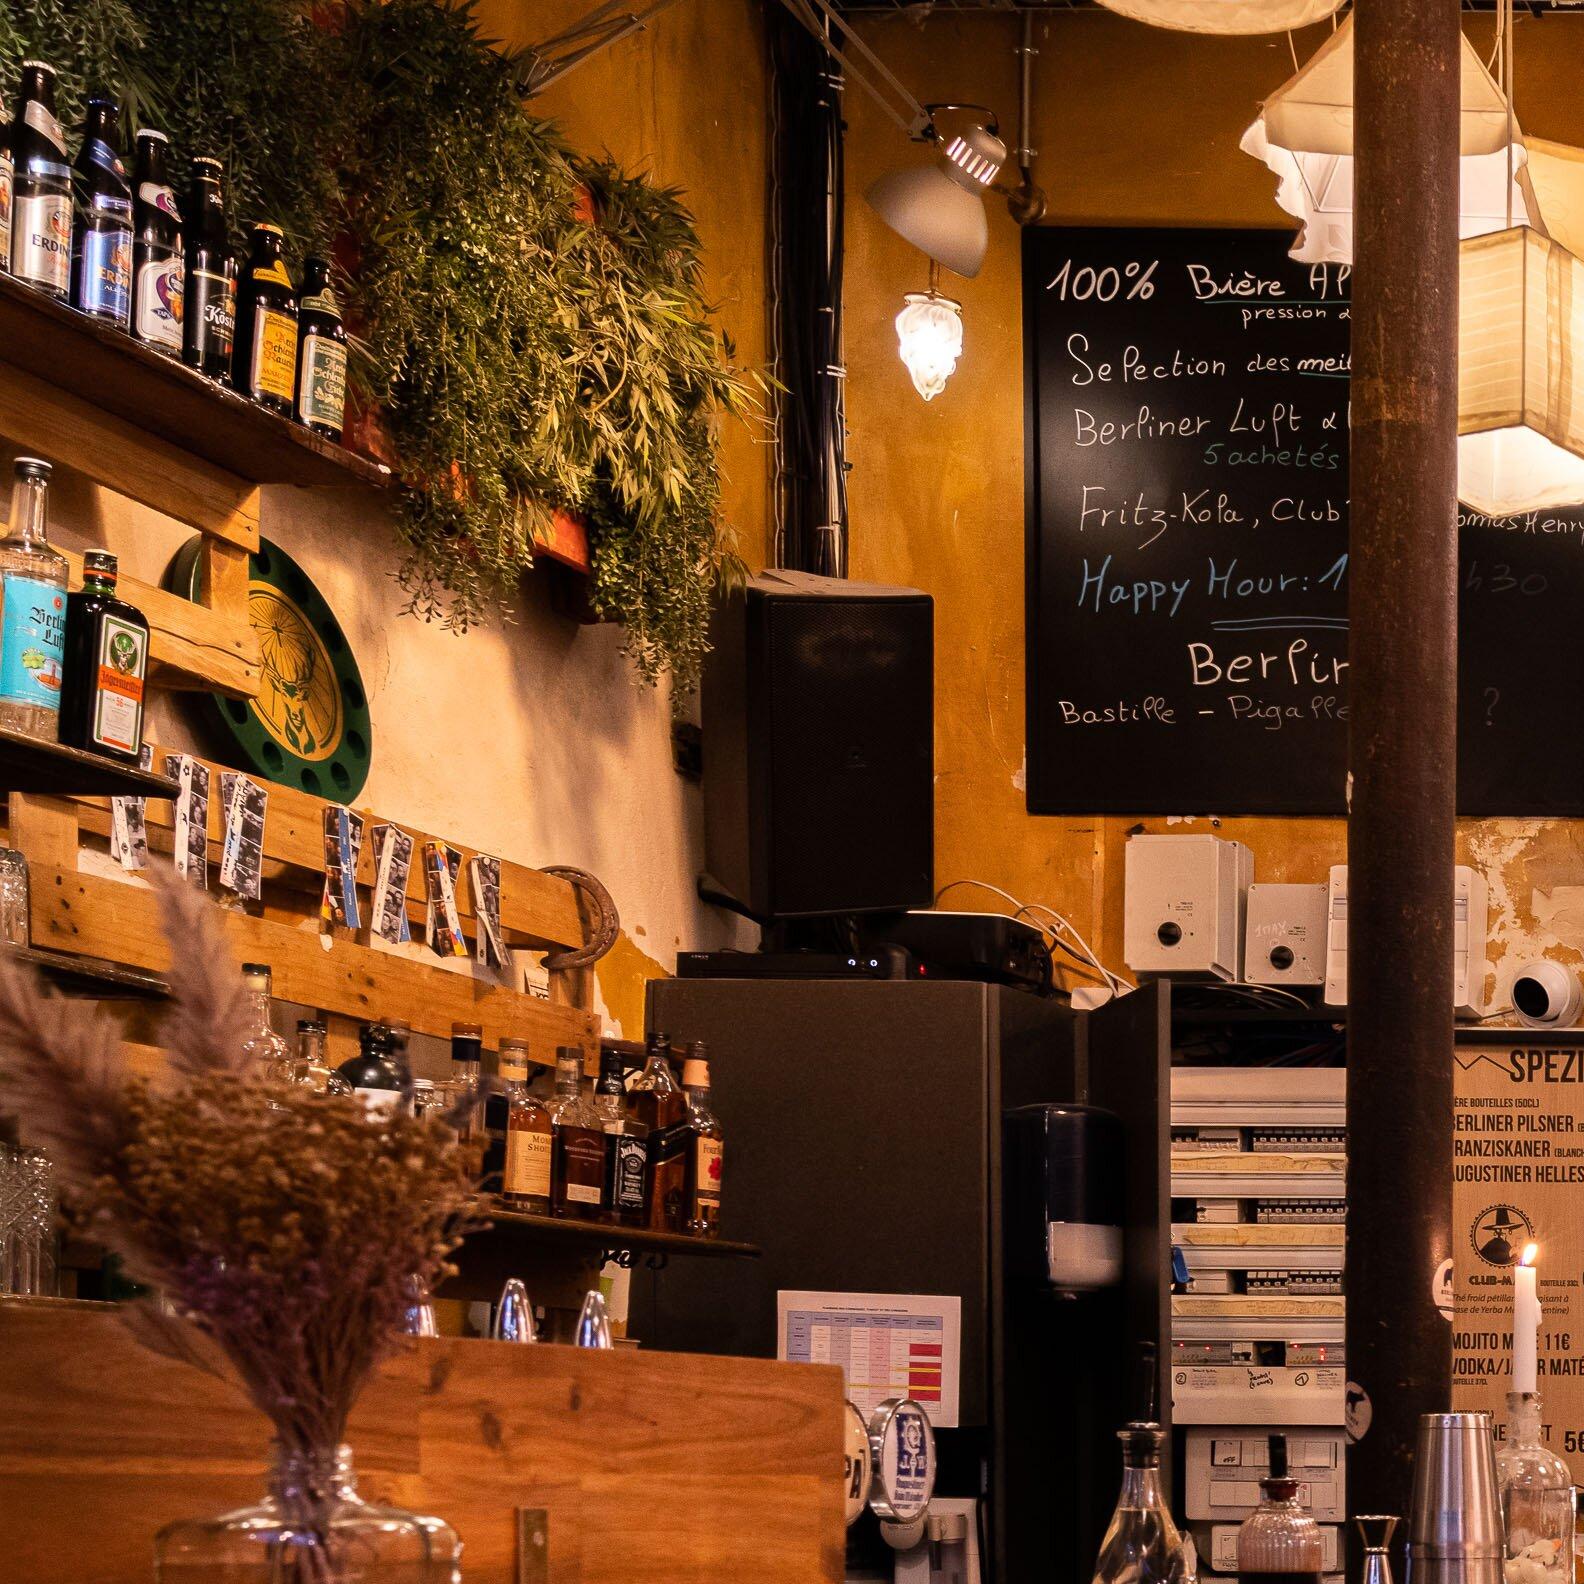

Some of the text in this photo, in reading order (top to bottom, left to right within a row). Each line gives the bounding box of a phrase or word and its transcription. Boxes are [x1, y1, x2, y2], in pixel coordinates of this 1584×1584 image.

[1046, 259, 1161, 302] 100%
[1187, 263, 1286, 300] Bière
[1241, 304, 1327, 330] pression
[1066, 332, 1226, 386] Selection
[1246, 353, 1290, 372] des
[1073, 406, 1211, 448] Berliner
[1229, 397, 1301, 448] Luft
[1203, 442, 1340, 470] 5 achetés
[1271, 497, 1341, 522] Club
[1077, 552, 1192, 618] Happy
[1317, 552, 1350, 592] 1
[1058, 700, 1177, 725] Bastille
[1470, 1097, 1513, 1109] BOUTEILLES
[1517, 1115, 1574, 1132] PILSNER
[1454, 1139, 1550, 1158] RANZISKANER
[1467, 1293, 1486, 1303] froid
[1471, 1306, 1480, 1314] de
[1481, 1305, 1501, 1315] Yerba
[1541, 1305, 1570, 1316] entine)
[1452, 1333, 1499, 1351] MOJITO
[1545, 1333, 1571, 1351] 11€
